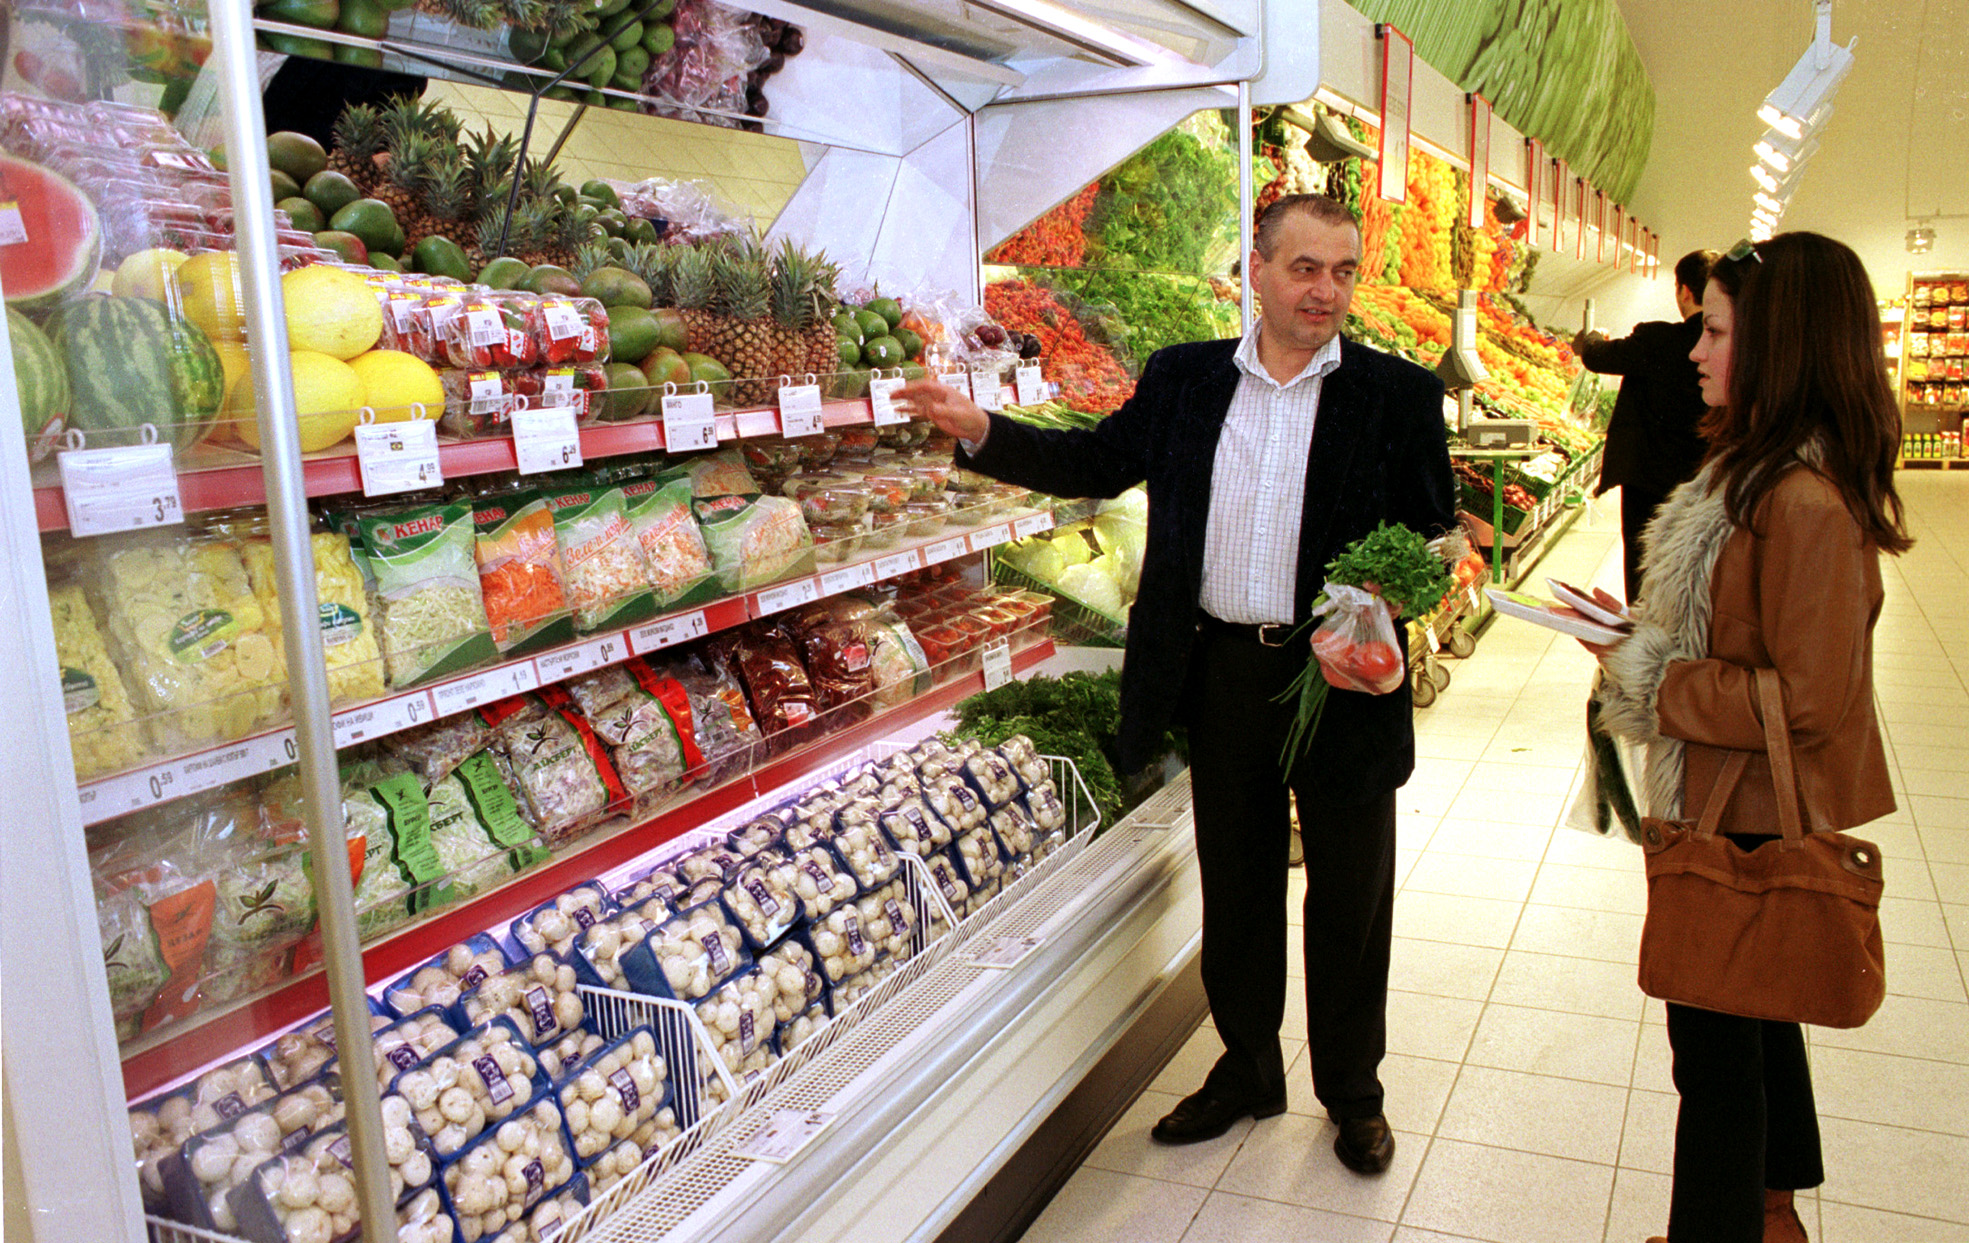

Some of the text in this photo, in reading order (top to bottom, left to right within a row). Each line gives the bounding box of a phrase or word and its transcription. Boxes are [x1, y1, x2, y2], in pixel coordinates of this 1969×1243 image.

[555, 493, 591, 509] КЕНАР
[623, 481, 657, 498] КЕНАР
[153, 496, 177, 522] 3.79
[394, 515, 444, 539] КЕНАР
[149, 771, 174, 799] 0.59
[429, 810, 464, 832] СБЕРГ
